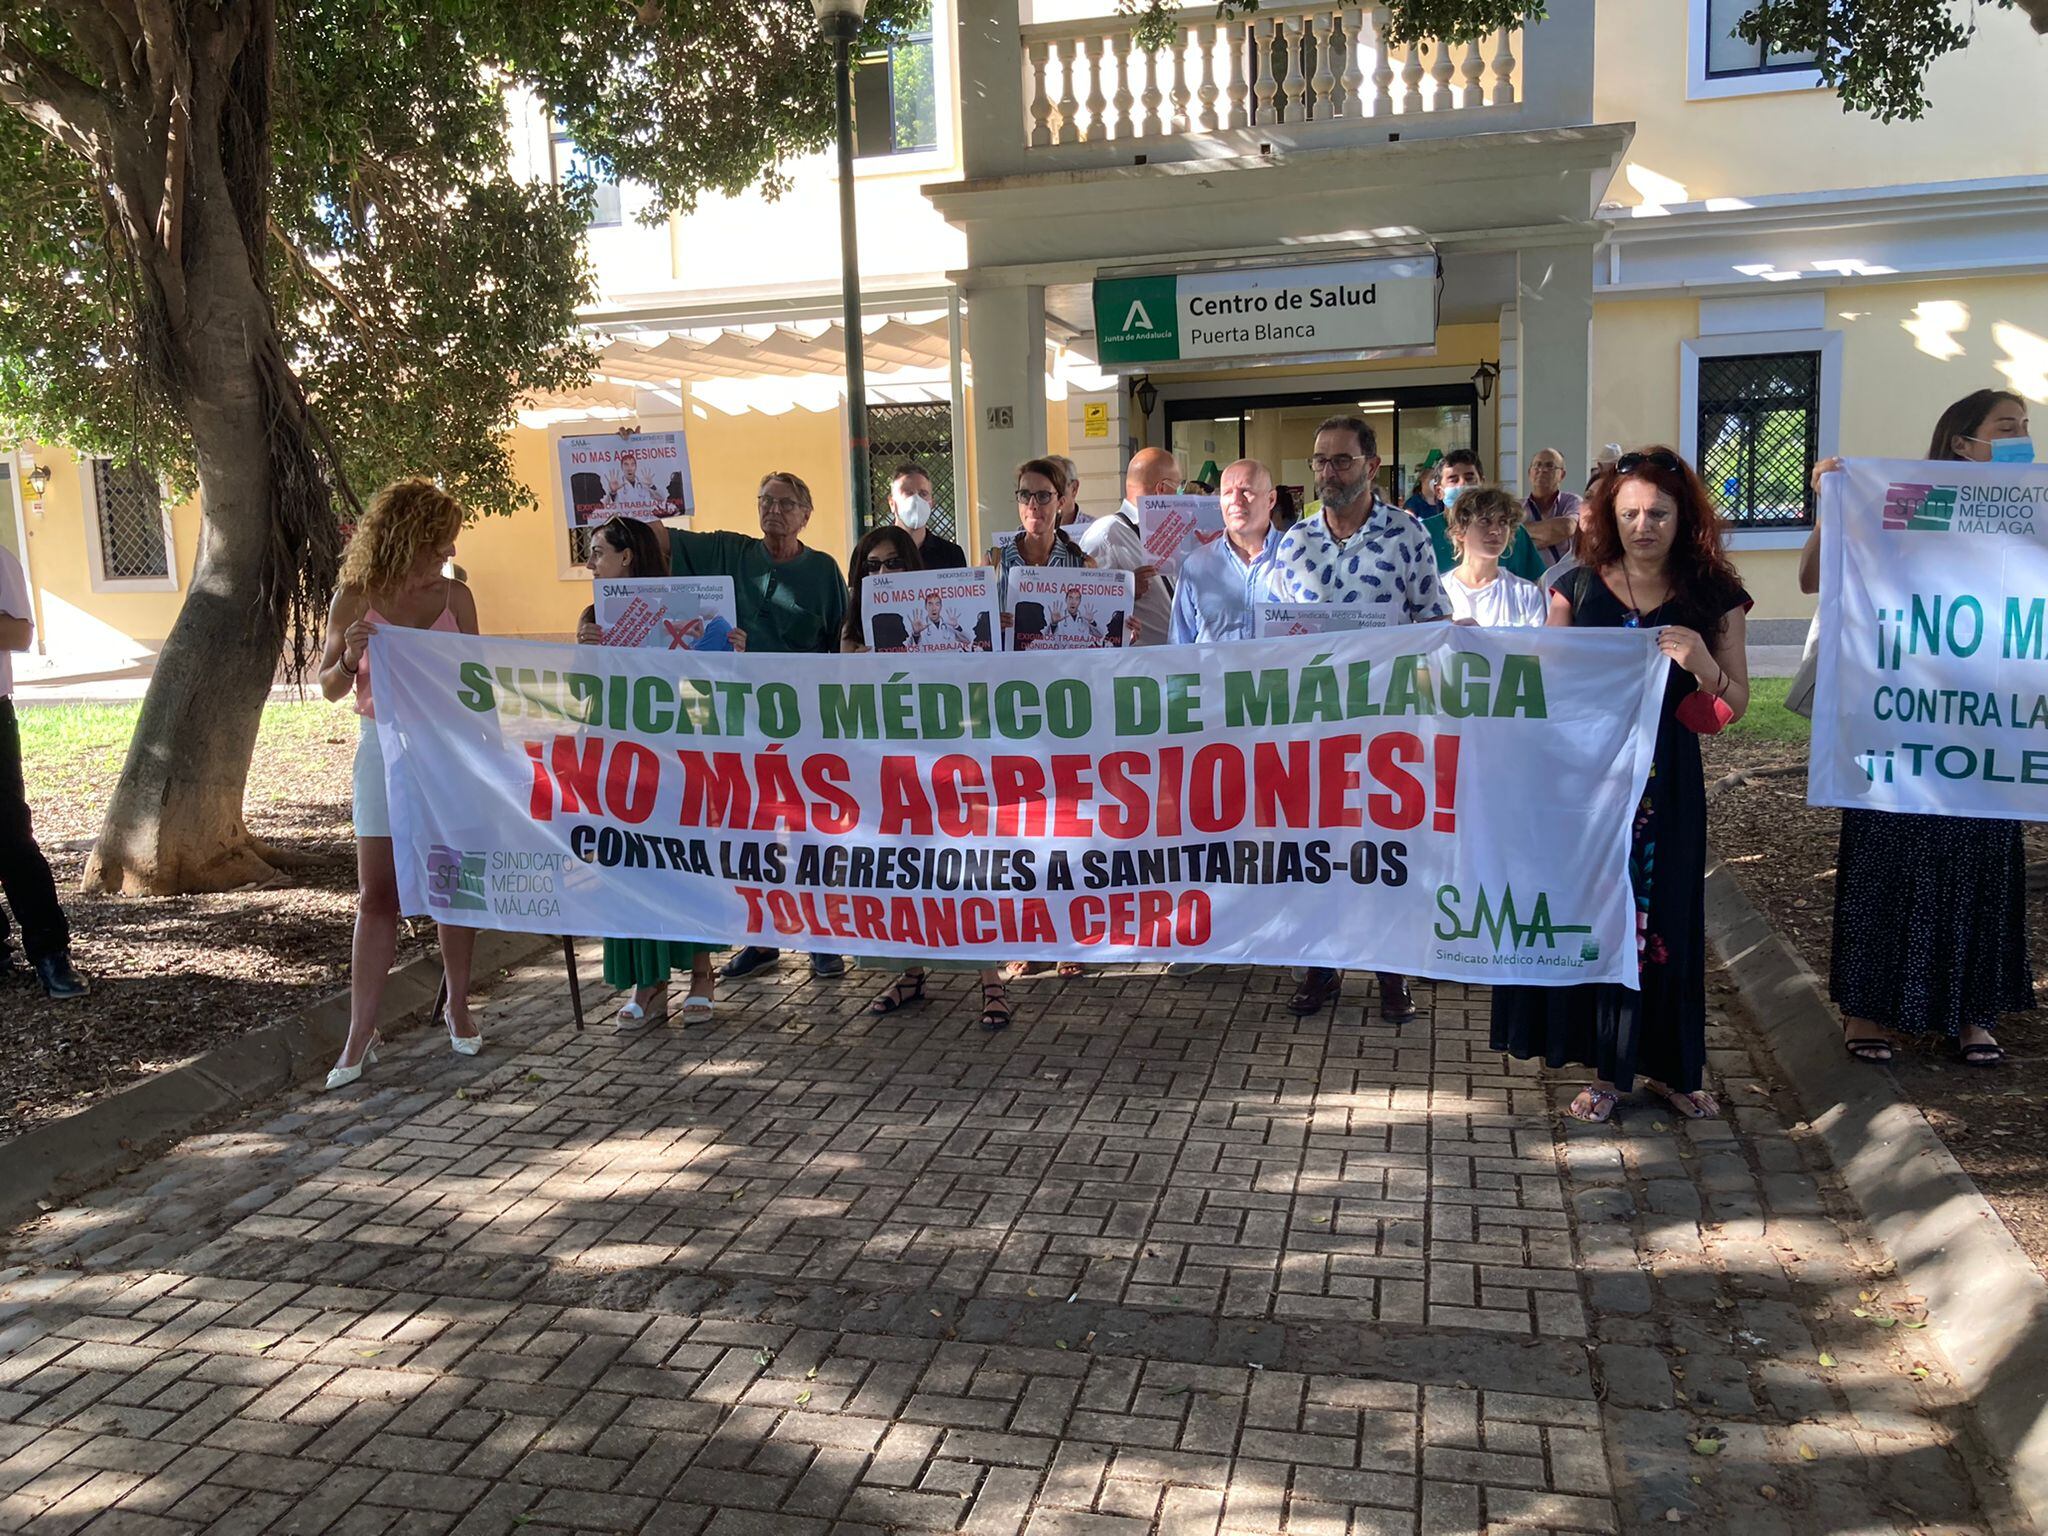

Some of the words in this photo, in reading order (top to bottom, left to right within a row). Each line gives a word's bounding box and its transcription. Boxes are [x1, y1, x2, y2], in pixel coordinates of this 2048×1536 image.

[1189, 294, 1268, 317] Centro
[1274, 289, 1303, 311] de
[1309, 283, 1377, 308] Salud
[1104, 335, 1124, 343] Junta
[1125, 333, 1135, 341] de
[1135, 330, 1172, 340] Andalucía
[1191, 327, 1250, 345] Puerta
[1255, 323, 1315, 341] Blanca
[987, 406, 1012, 428] 46
[571, 452, 587, 464] NO
[589, 450, 611, 463] MAS
[613, 446, 678, 462] AGRESIONES
[1144, 500, 1171, 510] SMA
[1958, 501, 2034, 519] MÉDICO
[1957, 518, 2036, 536] MÁLAGA
[603, 584, 635, 598] SMA
[696, 585, 724, 593] Andaluz
[873, 591, 889, 604] NO
[892, 589, 915, 603] MAS
[917, 584, 986, 599] AGRESIONES
[1019, 581, 1034, 593] NO
[1036, 582, 1058, 594] MAS
[1060, 583, 1125, 597] AGRESIONES
[1264, 609, 1296, 622] SMA
[1358, 612, 1386, 620] Andaluz
[922, 640, 969, 652] TRABAJAR
[1020, 642, 1060, 650] DIGNIDAD
[1058, 634, 1102, 644] TRABAJAR
[456, 661, 802, 740] SINDICATO
[818, 672, 1093, 740] MÉDICO
[1113, 673, 1205, 737] DE
[1223, 651, 1548, 728] MÁLAGA
[1873, 686, 2003, 728] CONTRA
[524, 735, 661, 824] ¡NO
[676, 743, 860, 836] MÁS
[878, 731, 1461, 839] AGRESIONES!
[491, 851, 573, 873] SINDICATO
[570, 824, 716, 877] CONTRA
[719, 840, 788, 885] LAS
[794, 844, 1037, 892] AGRESIONES
[1046, 849, 1075, 891] A
[1083, 839, 1408, 889] SANITARIAS-OS
[492, 871, 554, 894] MÉDICO
[494, 894, 561, 918] MÁLAGA
[735, 886, 1058, 948] TOLERANCIA
[1068, 889, 1212, 948] CERO
[1434, 881, 1592, 952] SMA
[1436, 949, 1489, 965] Sindicato
[1492, 952, 1533, 966] Médico
[1536, 954, 1584, 968] Andaluz
